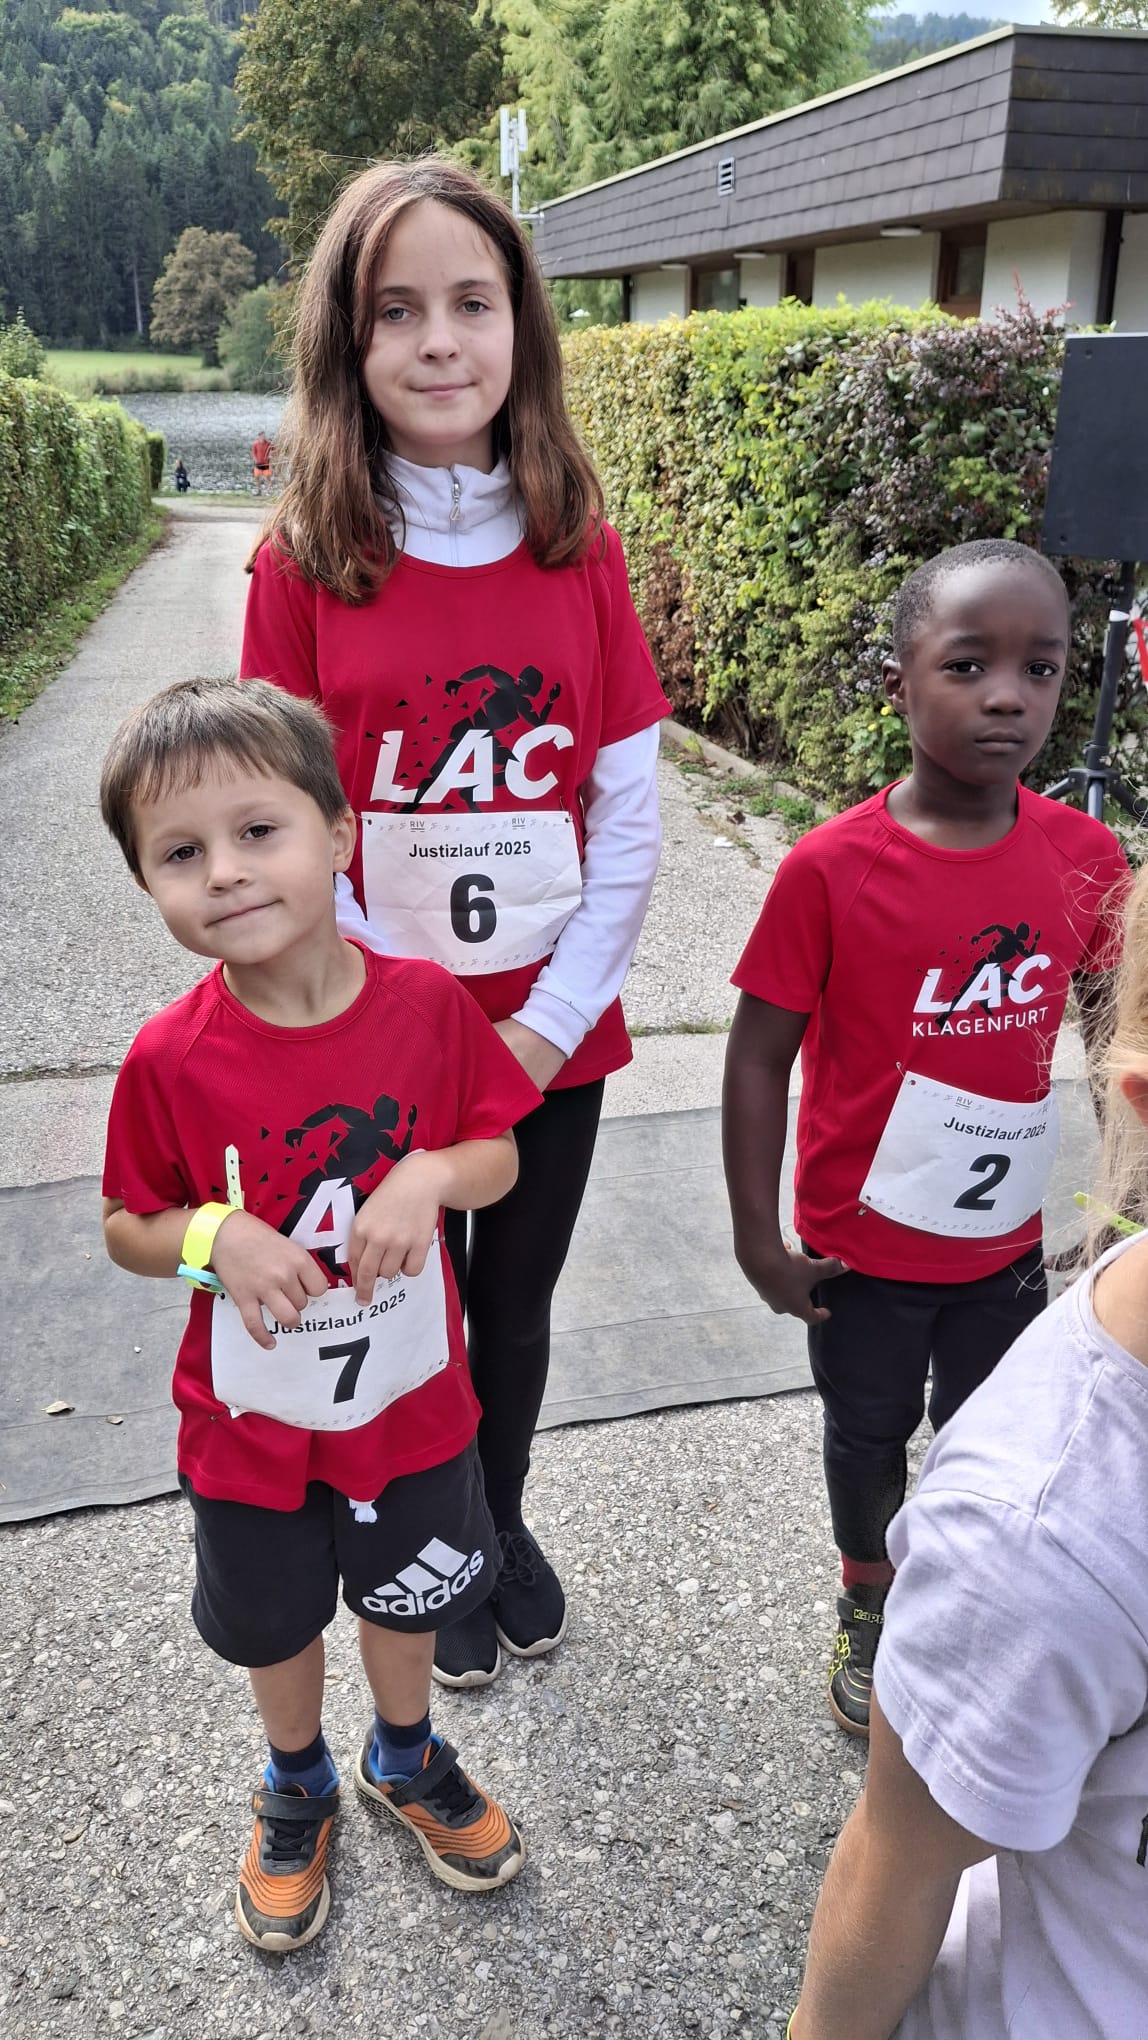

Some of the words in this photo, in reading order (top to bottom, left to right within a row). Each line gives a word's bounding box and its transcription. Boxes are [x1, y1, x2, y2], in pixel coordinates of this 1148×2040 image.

[370, 724, 575, 804] LAC
[410, 820, 425, 828] RIV
[512, 817, 526, 825] RIV
[409, 843, 490, 858] Justizlauf
[495, 840, 532, 856] 2025
[450, 873, 497, 943] 6
[913, 954, 1051, 1014] LAC
[912, 1006, 1049, 1037] KLAGENFURT
[956, 1096, 973, 1106] RIV
[943, 1117, 1023, 1140] Justizlauf
[1022, 1121, 1047, 1140] 2025
[953, 1153, 1011, 1211] 2
[369, 1288, 406, 1318] 2025
[318, 1335, 371, 1404] 7
[362, 1549, 484, 1616] adidas
[853, 1608, 884, 1624] Kapp
